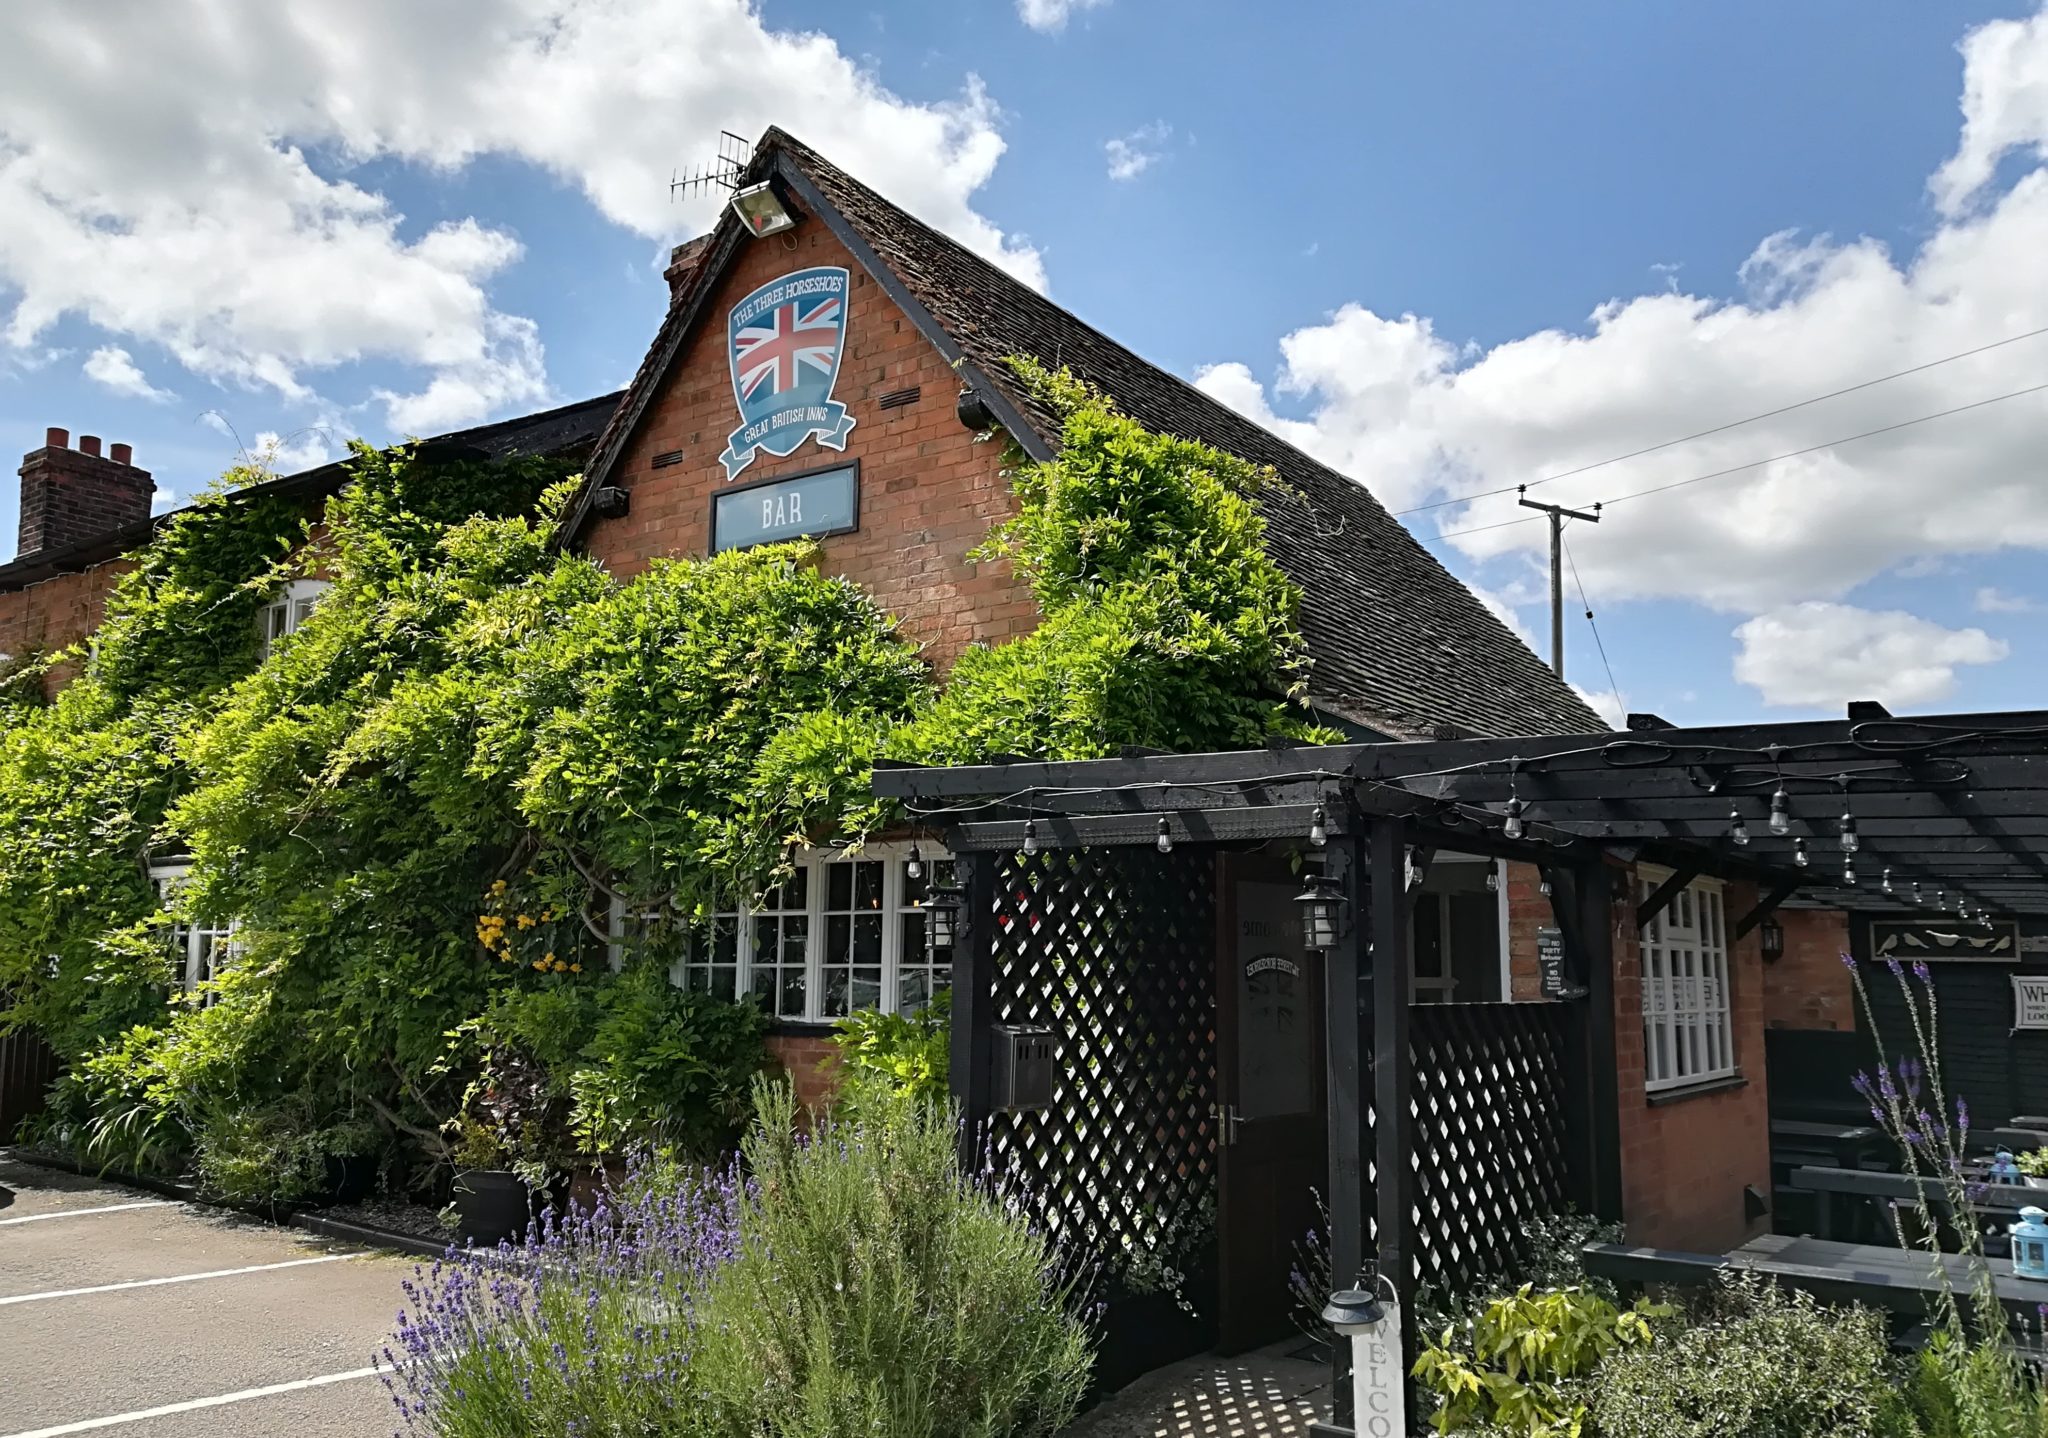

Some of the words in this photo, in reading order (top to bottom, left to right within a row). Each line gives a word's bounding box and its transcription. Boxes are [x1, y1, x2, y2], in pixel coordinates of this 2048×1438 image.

[734, 303, 754, 328] THE
[753, 286, 784, 314] THREE
[785, 275, 844, 300] HORSESHOES
[744, 418, 769, 444] GREAT
[771, 407, 805, 430] BRITISH
[806, 406, 828, 422] INNS
[761, 492, 802, 529] BAR
